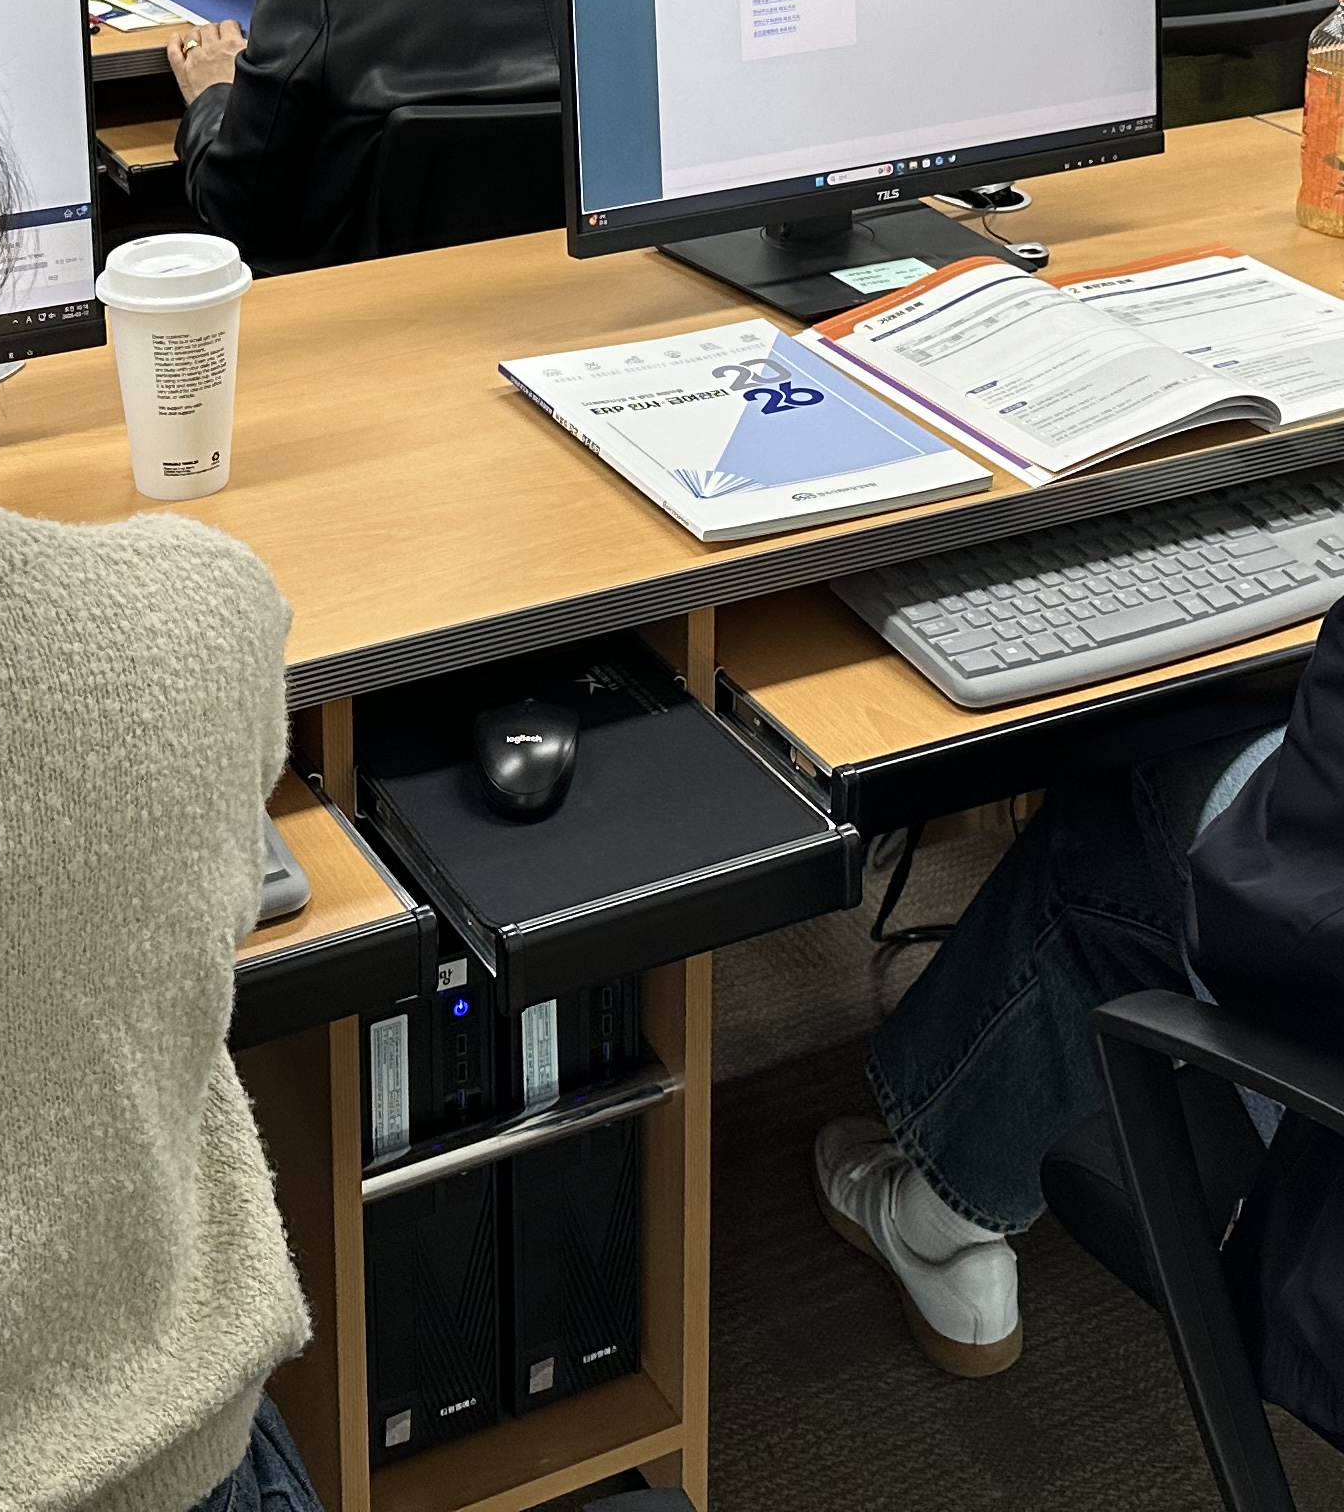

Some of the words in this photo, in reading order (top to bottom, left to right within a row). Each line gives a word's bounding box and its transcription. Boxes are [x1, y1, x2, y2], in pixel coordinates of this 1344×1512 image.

[669, 351, 728, 366] INFORMATION
[711, 358, 793, 392] 20
[742, 380, 825, 415] 26
[589, 405, 625, 416] ERP
[506, 733, 543, 745] logitech
